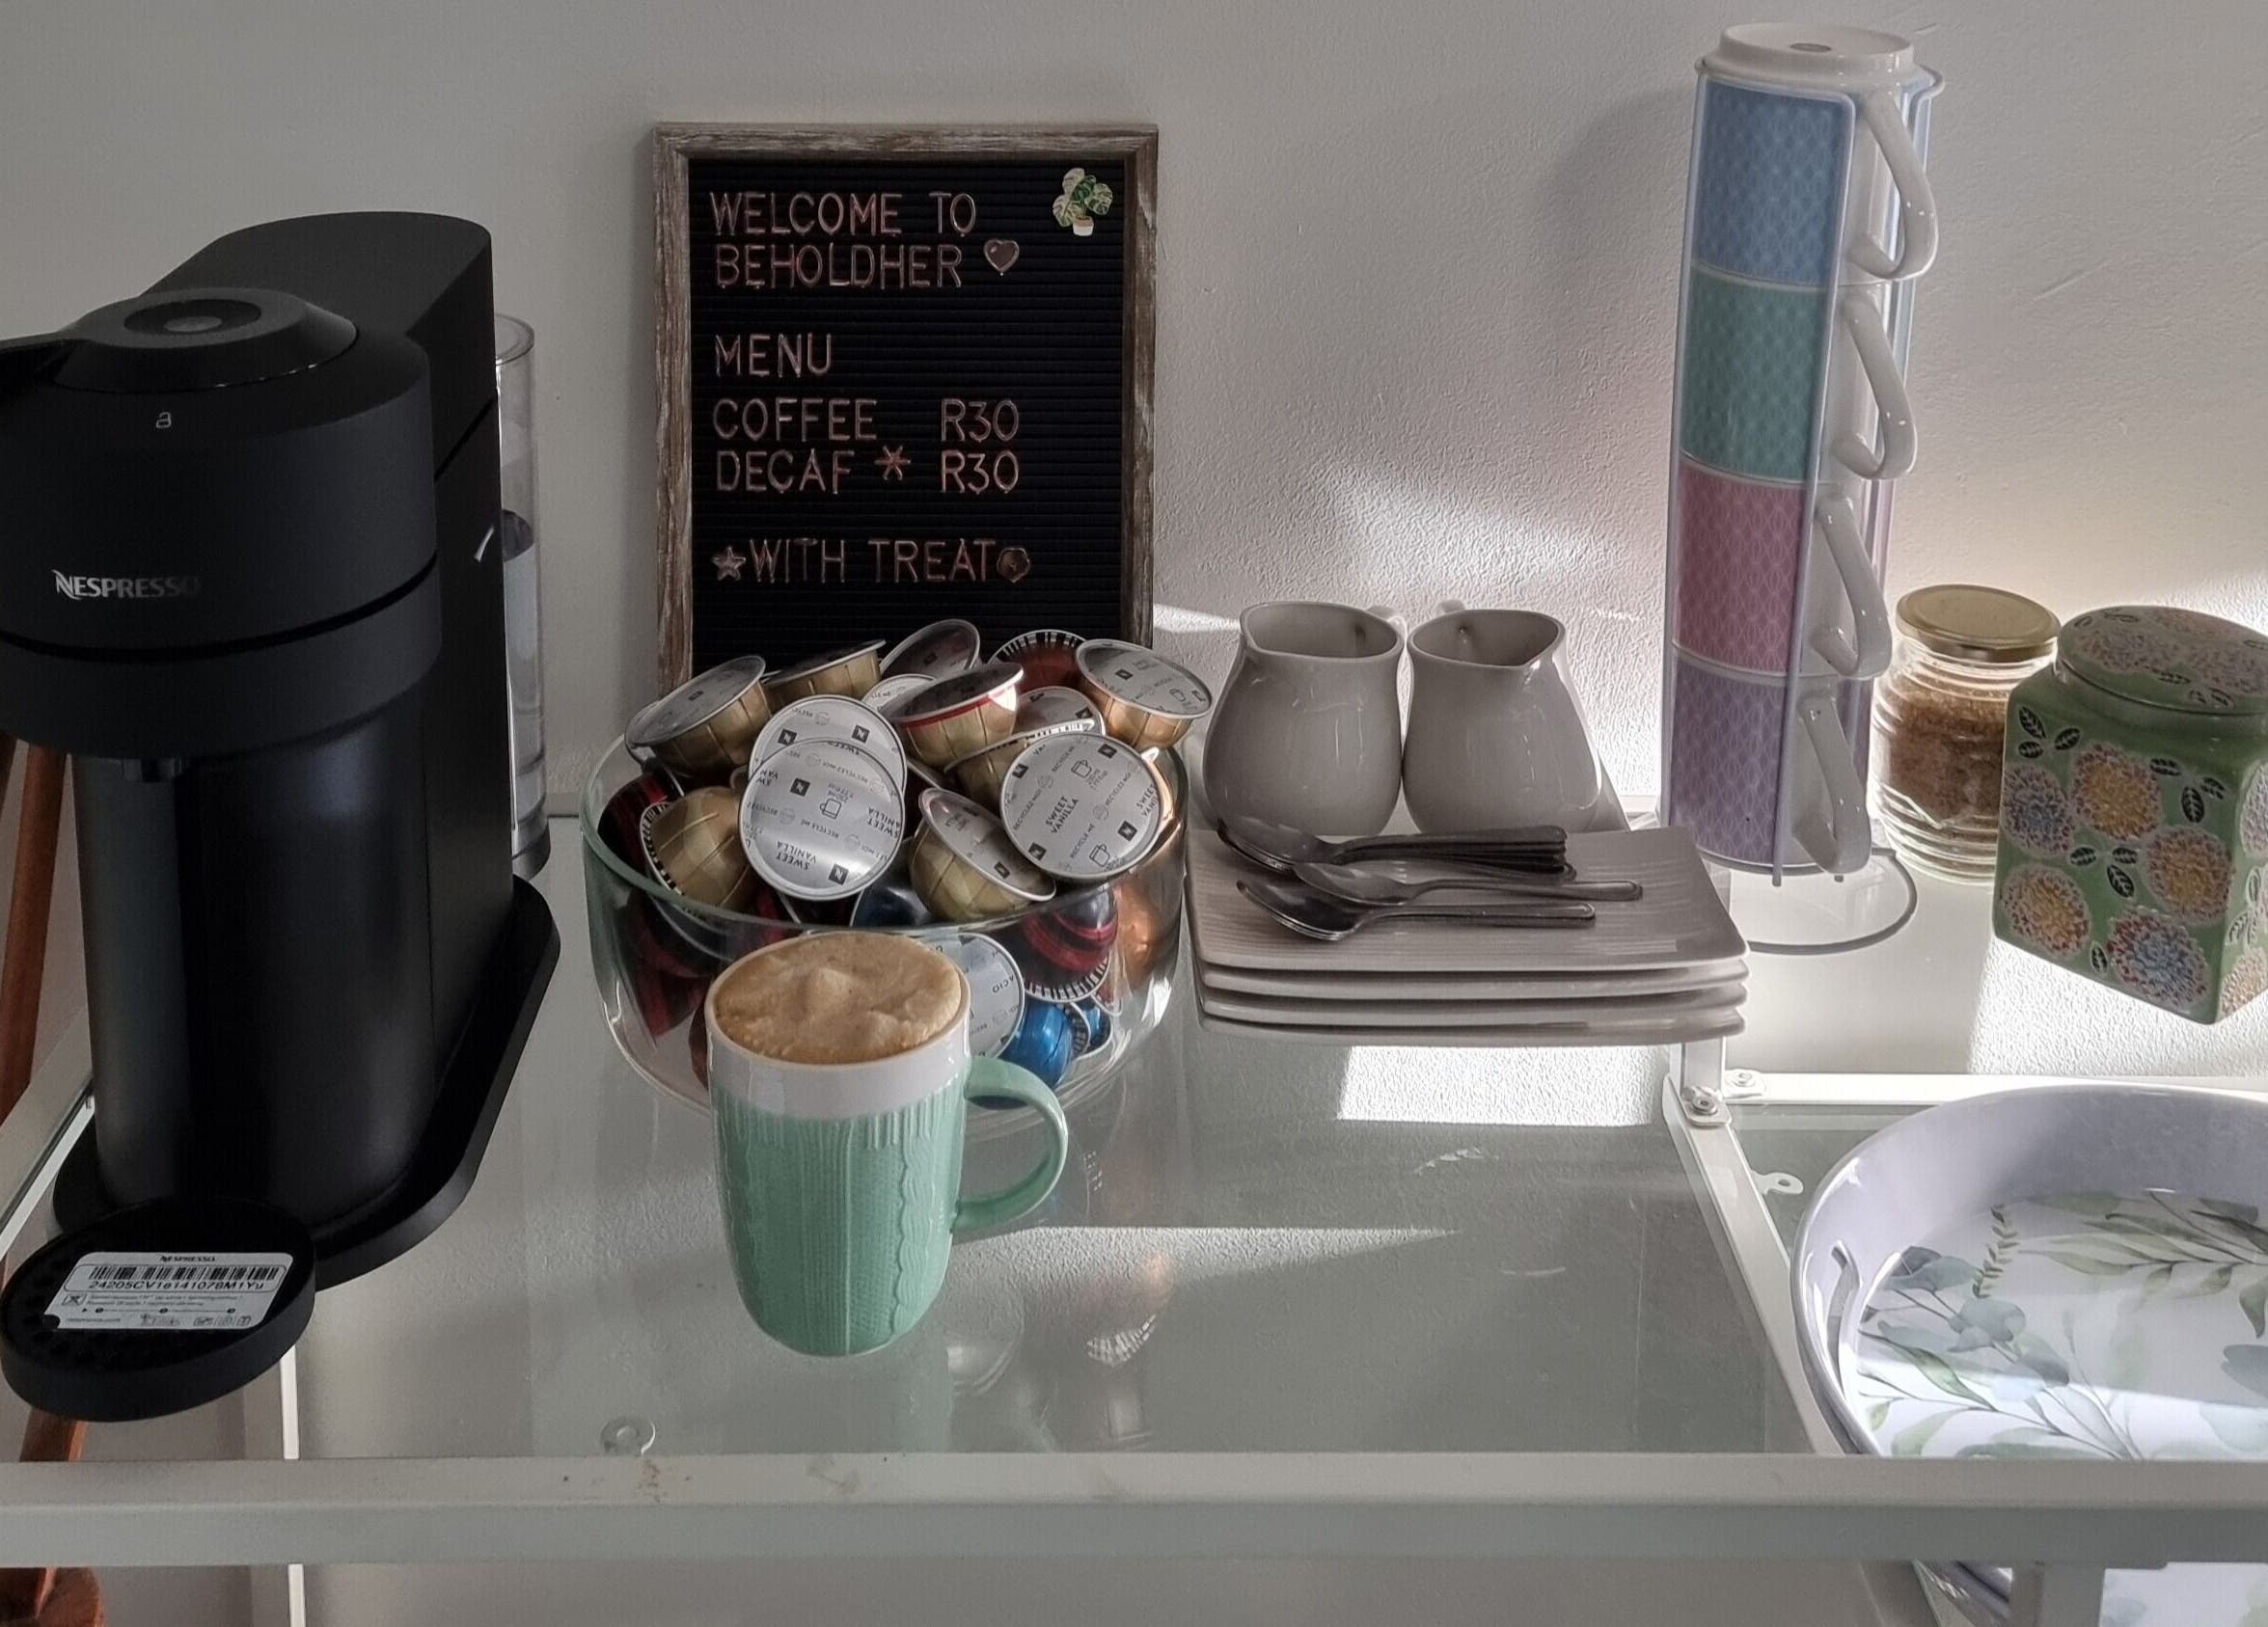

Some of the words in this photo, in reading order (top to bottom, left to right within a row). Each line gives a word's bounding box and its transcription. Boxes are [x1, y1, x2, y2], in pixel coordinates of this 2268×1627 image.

[710, 192, 903, 235] WELCOME
[930, 192, 976, 235] TO
[715, 243, 964, 287] BEHOLDHER
[714, 333, 832, 376] MENU
[714, 397, 877, 442] COFFEE
[941, 397, 1020, 442] R30
[716, 448, 856, 494] DECAF
[941, 449, 1020, 494] R30
[749, 537, 846, 583] WITH
[868, 537, 997, 583] TREAT
[51, 569, 201, 600] NESPRESSO
[868, 818, 898, 837] SWEET
[1045, 796, 1069, 827] SWEET
[1052, 798, 1079, 833] VANILLA
[777, 852, 809, 870] SWEET
[778, 840, 816, 863] VANILLA
